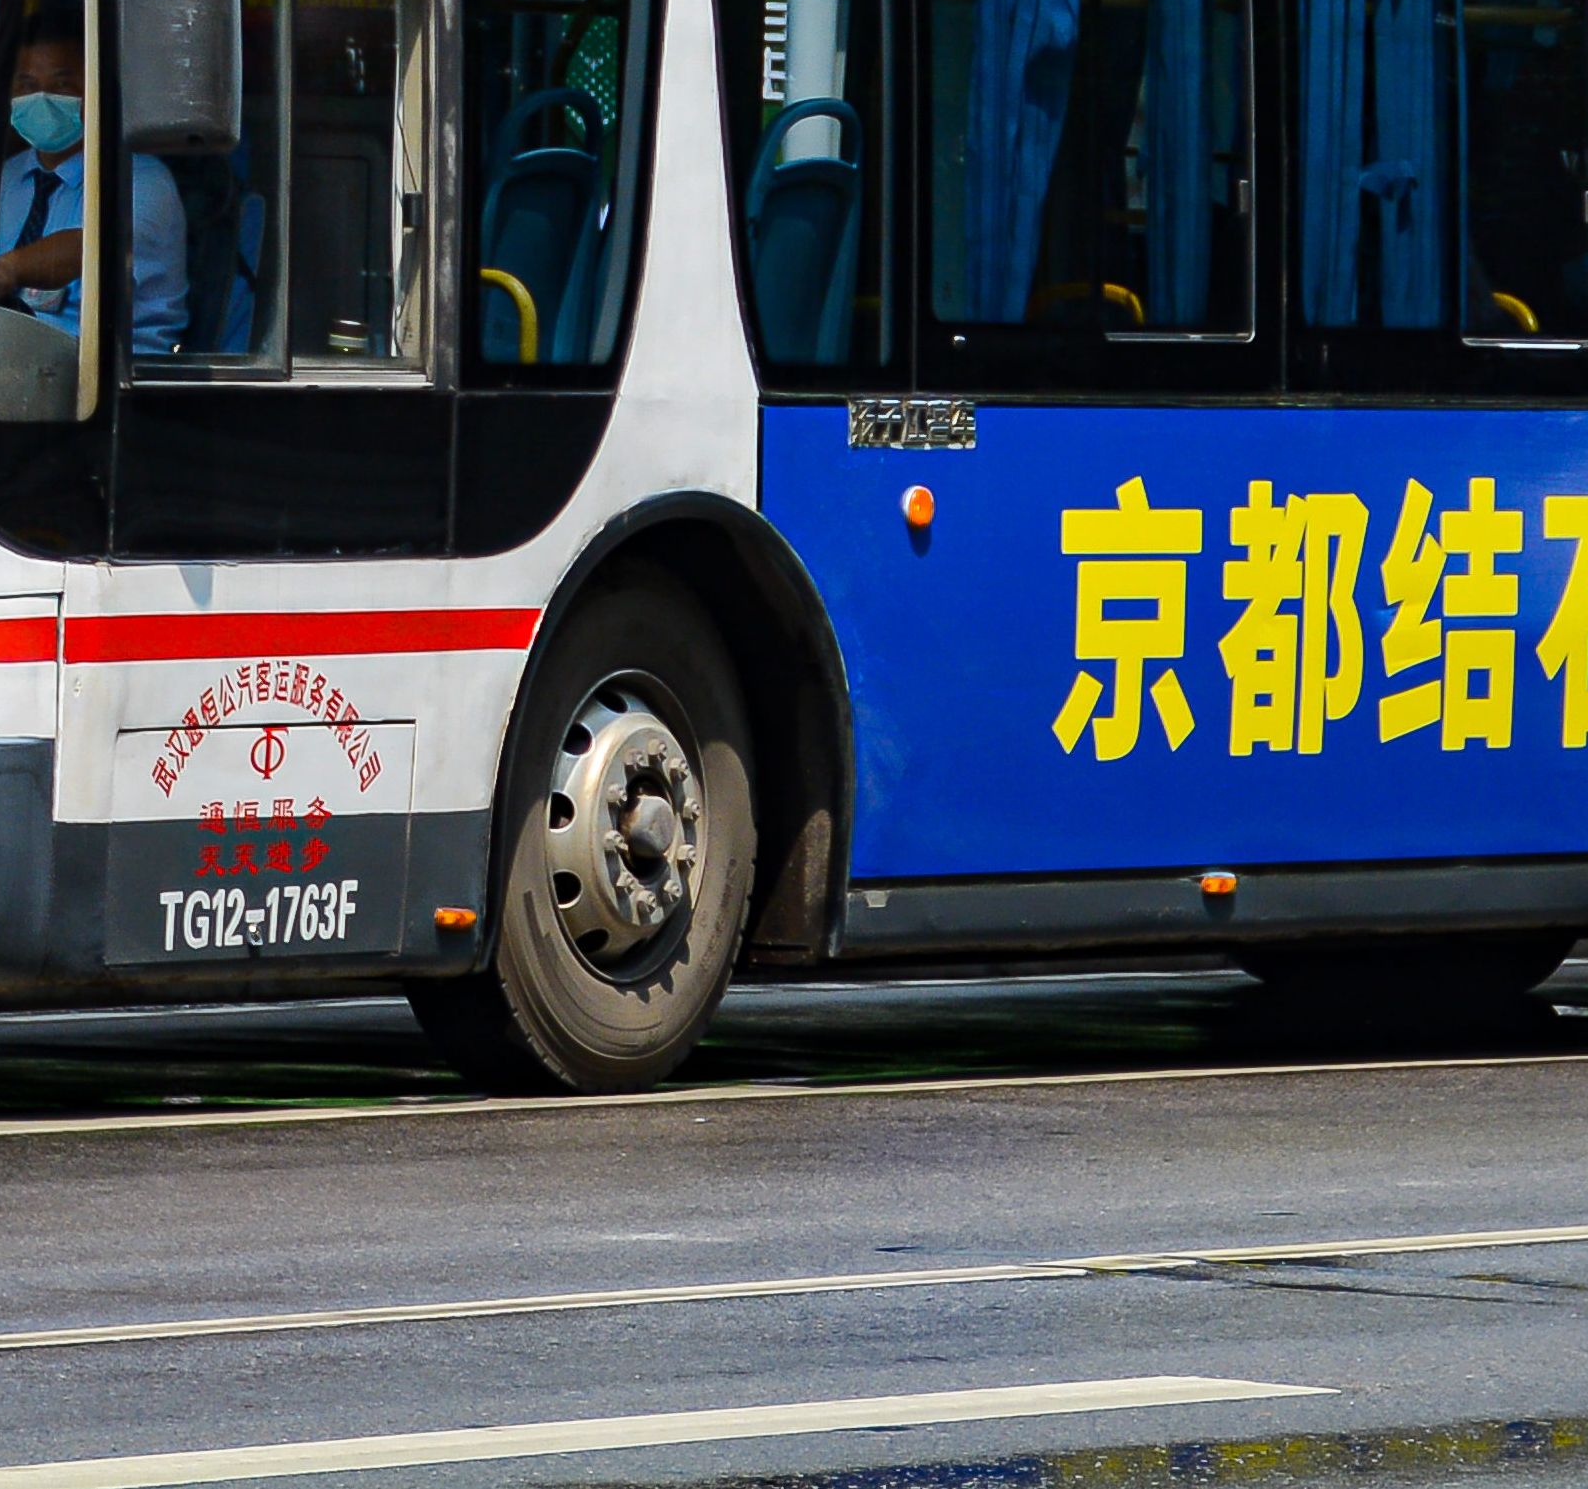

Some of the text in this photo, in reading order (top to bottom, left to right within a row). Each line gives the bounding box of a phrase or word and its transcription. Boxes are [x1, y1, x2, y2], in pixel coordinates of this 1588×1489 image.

[151, 660, 382, 799] 武汉通恒公汽客运服务有限公司
[159, 879, 359, 952] TG12-1763F
